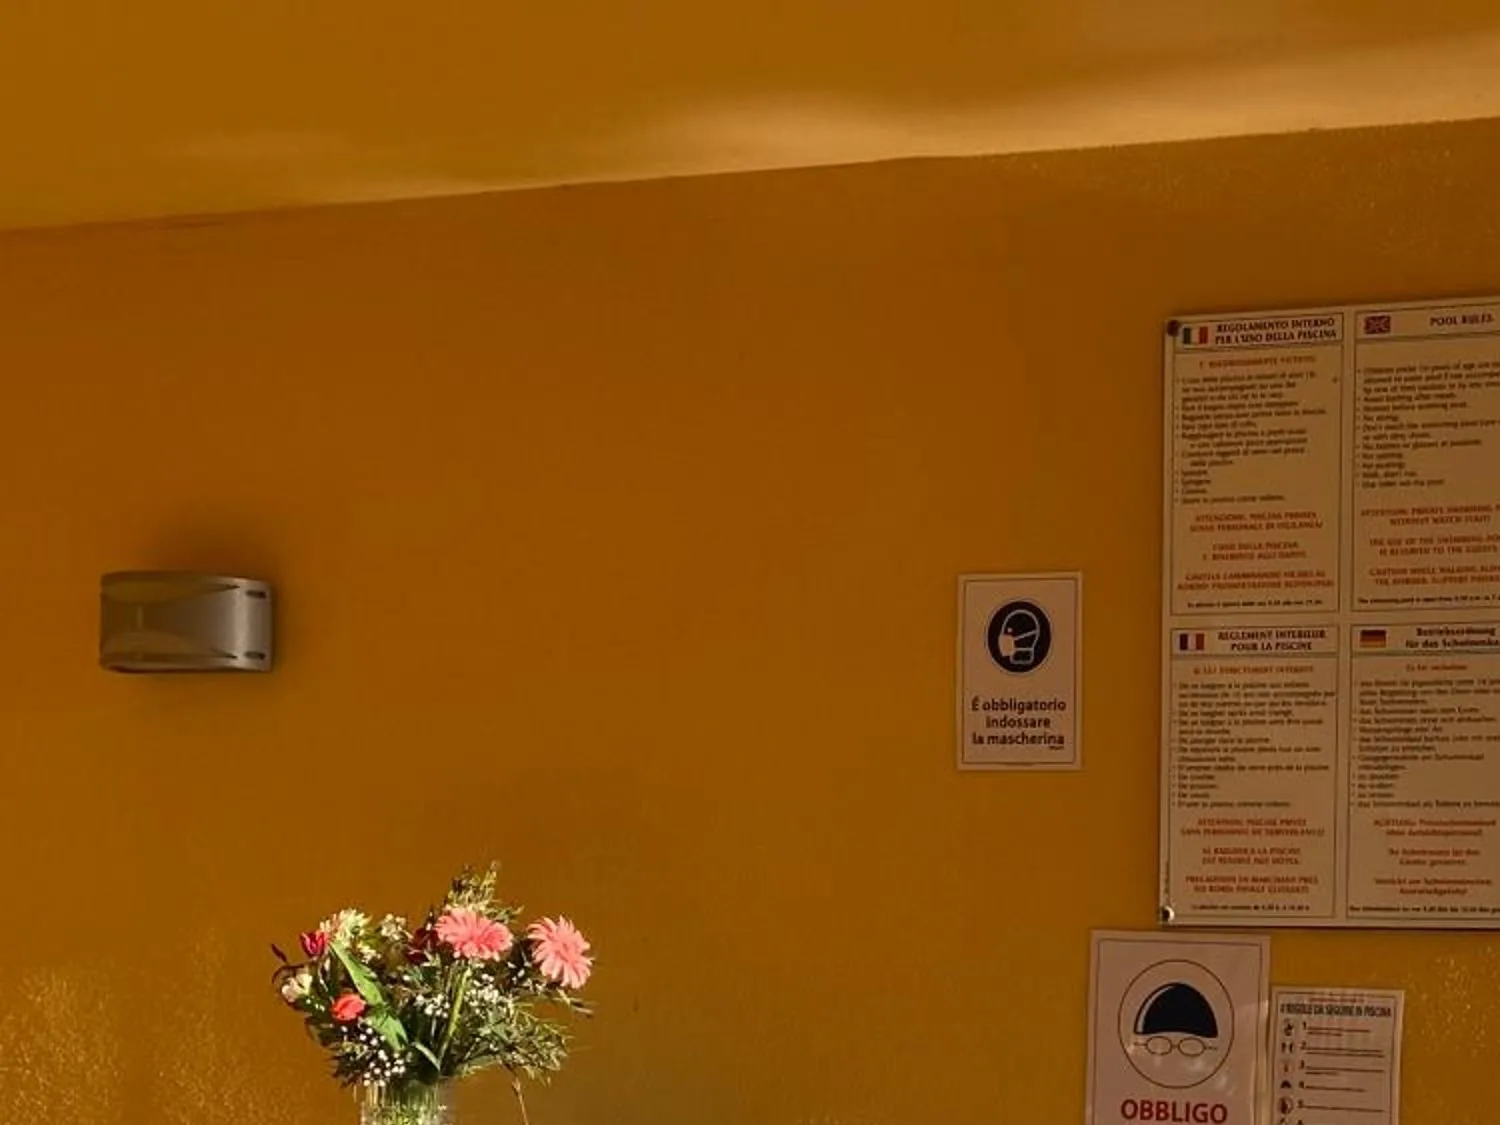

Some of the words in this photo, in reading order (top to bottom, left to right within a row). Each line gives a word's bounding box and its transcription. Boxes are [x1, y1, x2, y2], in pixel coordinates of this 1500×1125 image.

[1430, 316, 1458, 326] POOL
[982, 697, 1066, 714] obbligatorio
[986, 715, 1050, 729] indossare
[972, 732, 984, 745] la
[987, 731, 1064, 745] mascherina
[1121, 1099, 1228, 1124] OBBLIGO
